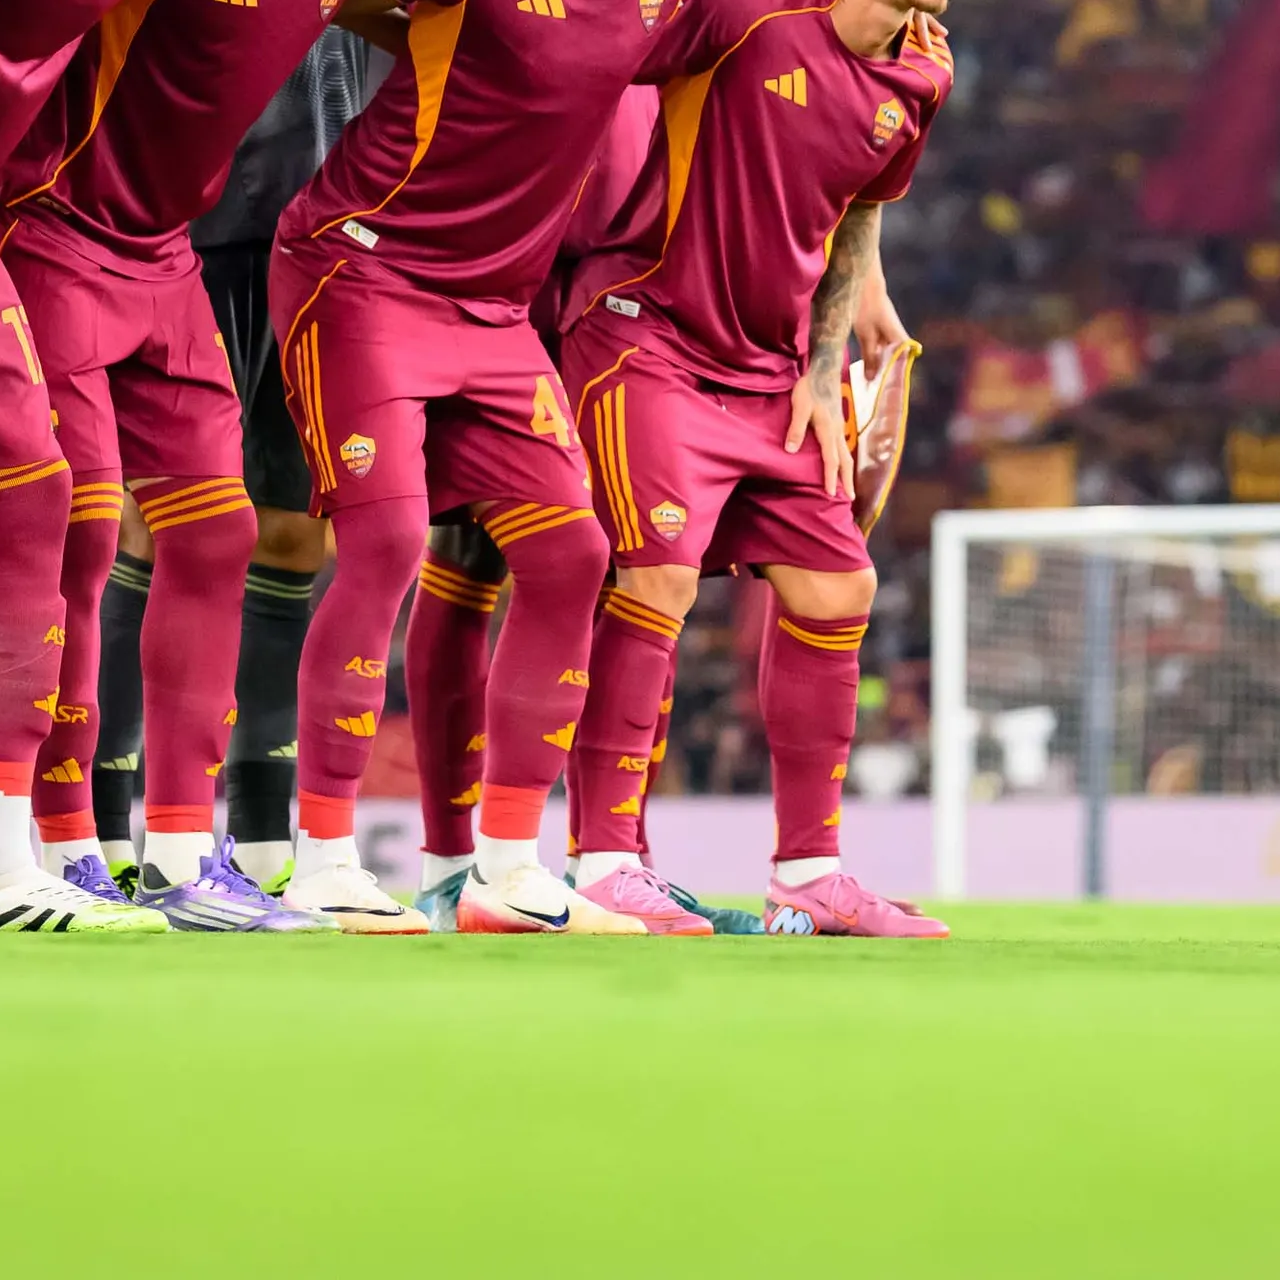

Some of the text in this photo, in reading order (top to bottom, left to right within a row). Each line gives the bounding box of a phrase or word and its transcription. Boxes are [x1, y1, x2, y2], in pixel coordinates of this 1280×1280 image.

[1, 305, 44, 385] 1
[530, 372, 581, 448] 4
[54, 705, 89, 724] SR
